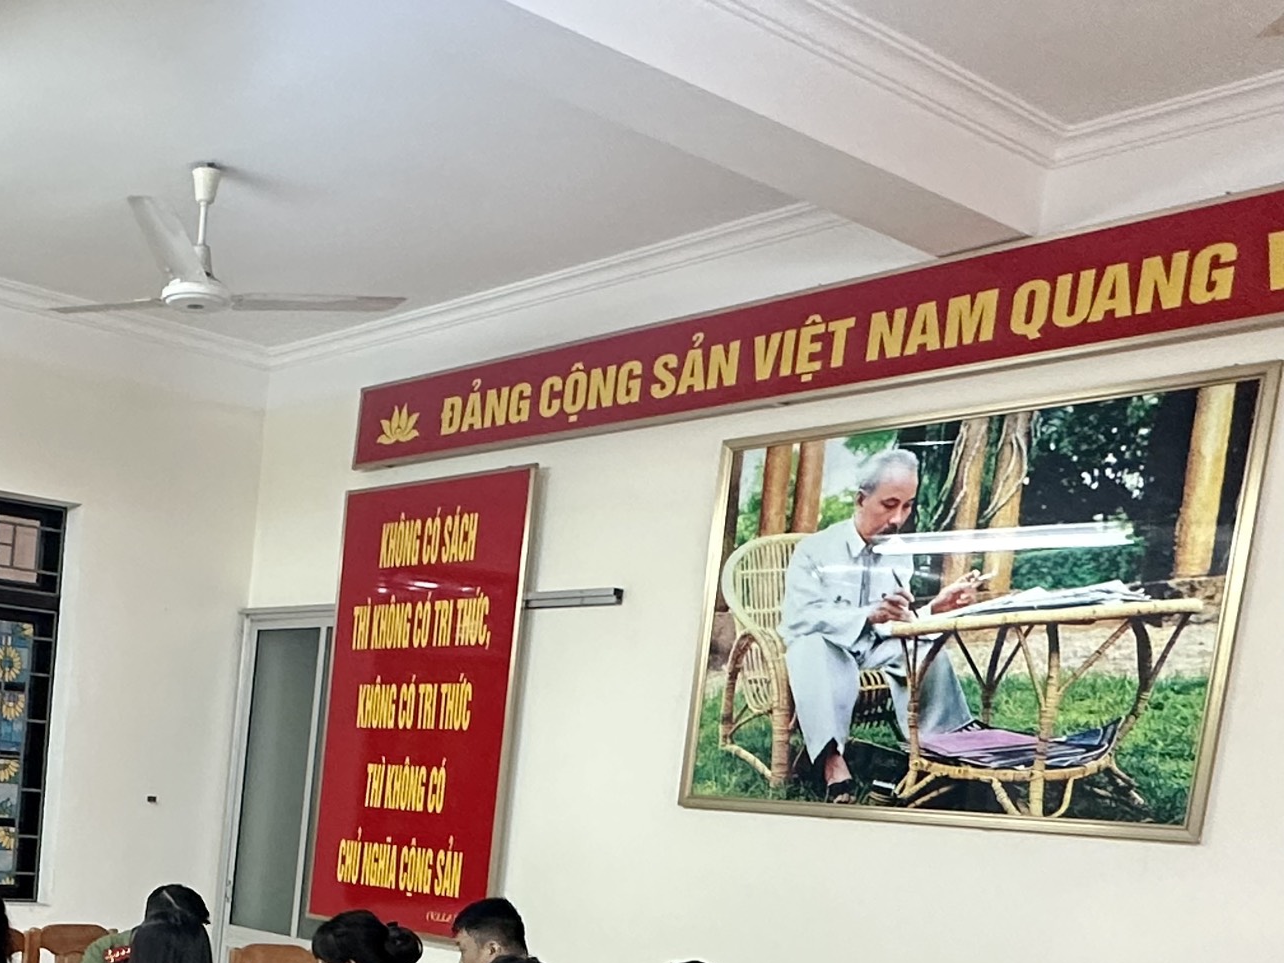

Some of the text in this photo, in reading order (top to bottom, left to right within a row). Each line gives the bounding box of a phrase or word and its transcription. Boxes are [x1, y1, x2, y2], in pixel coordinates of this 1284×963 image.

[441, 378, 532, 436] ĐẢNG
[539, 362, 643, 423] CỘNG
[650, 332, 740, 400] SẢN
[754, 313, 856, 383] VIỆT
[866, 288, 999, 362] NAM
[1010, 243, 1238, 340] QUANG
[379, 505, 479, 569] KHÔNG CÓ SÁCH
[352, 597, 371, 650] THÌ
[370, 594, 412, 650] KHÔNG
[412, 591, 432, 648] CÓ
[432, 599, 454, 647] TRI
[356, 672, 473, 731] KHÔNG CÓ TRI THỨC
[364, 755, 447, 814] THÌ KHÔNG CÓ
[336, 826, 463, 898] CHỦ NGHĨA CỘNG SẢN
